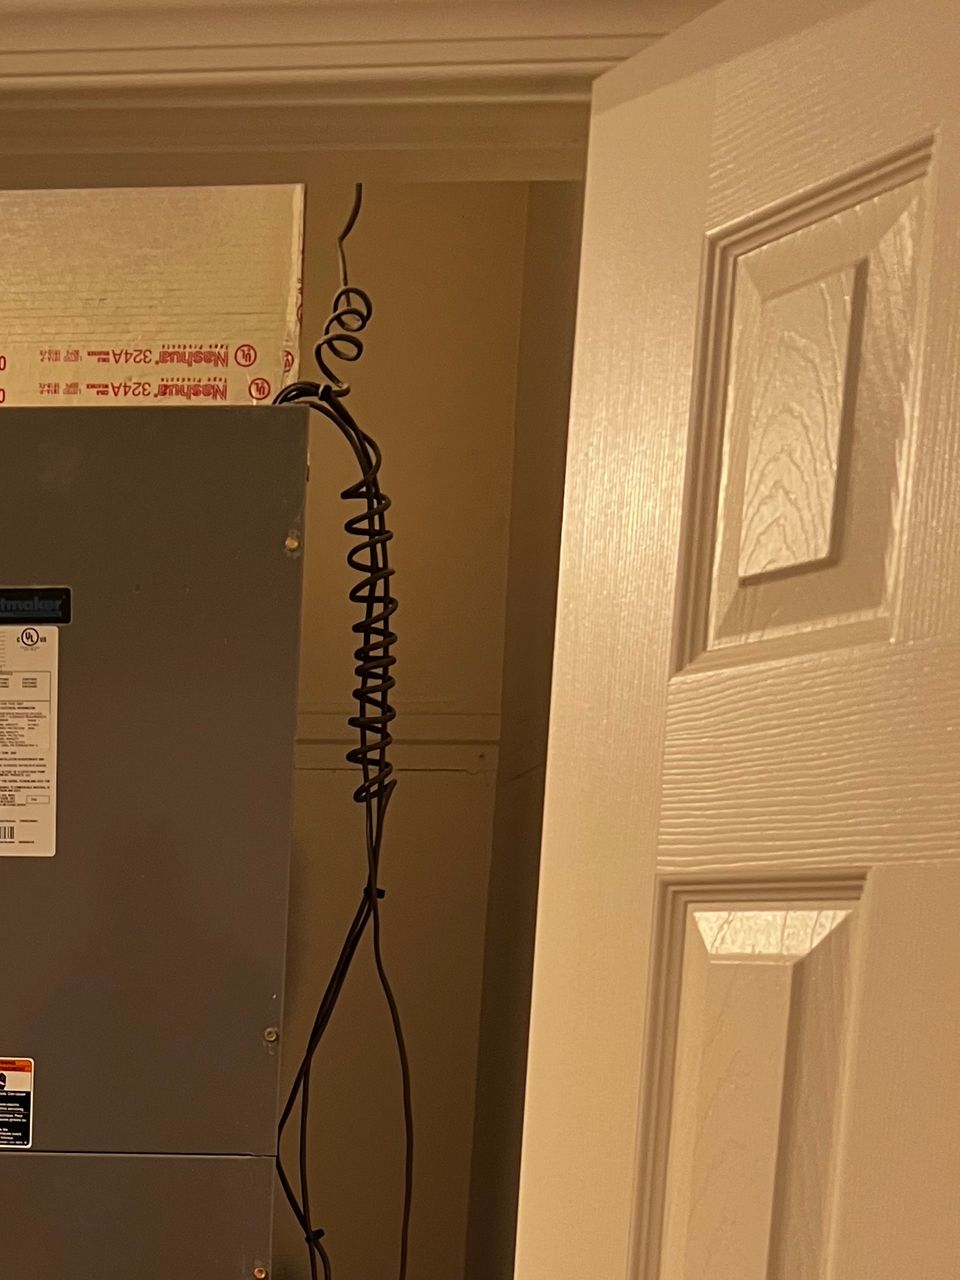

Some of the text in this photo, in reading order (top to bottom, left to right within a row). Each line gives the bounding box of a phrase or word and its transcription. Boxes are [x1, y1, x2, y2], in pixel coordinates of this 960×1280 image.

[112, 349, 152, 364] 324A
[158, 350, 228, 368] Nashua
[111, 382, 151, 397] 324A
[157, 383, 227, 401] Nashua
